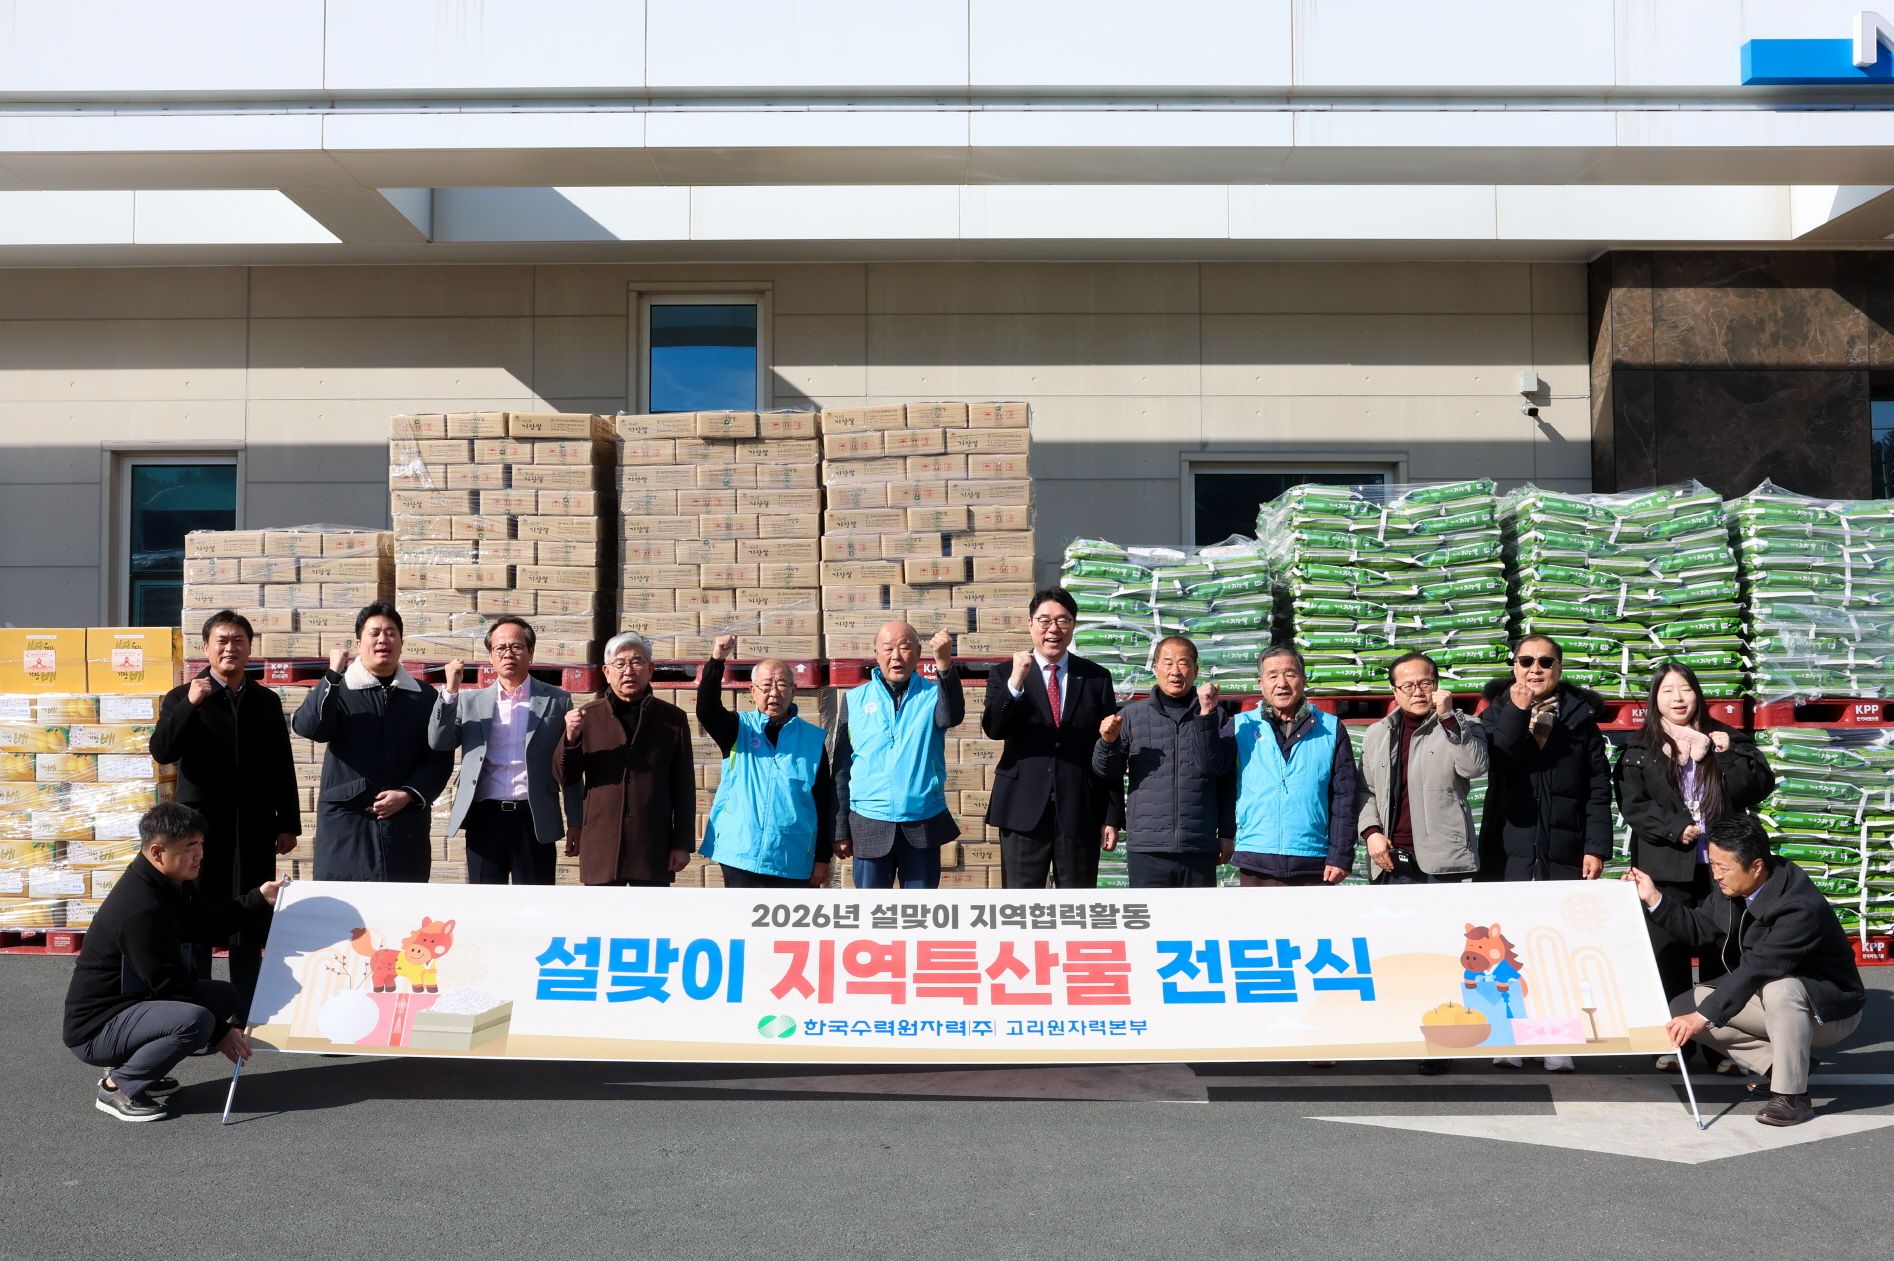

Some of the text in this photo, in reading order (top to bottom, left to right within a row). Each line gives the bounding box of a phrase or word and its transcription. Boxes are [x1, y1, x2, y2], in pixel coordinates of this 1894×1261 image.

[1855, 704, 1879, 715] KPP
[752, 903, 1151, 930] 2026년 설맞이 지역협력활동
[1861, 942, 1885, 952] KPP
[535, 936, 1375, 1006] 설맞이 지역특산물 전달식
[1006, 1019, 1148, 1037] 고리원자력본부
